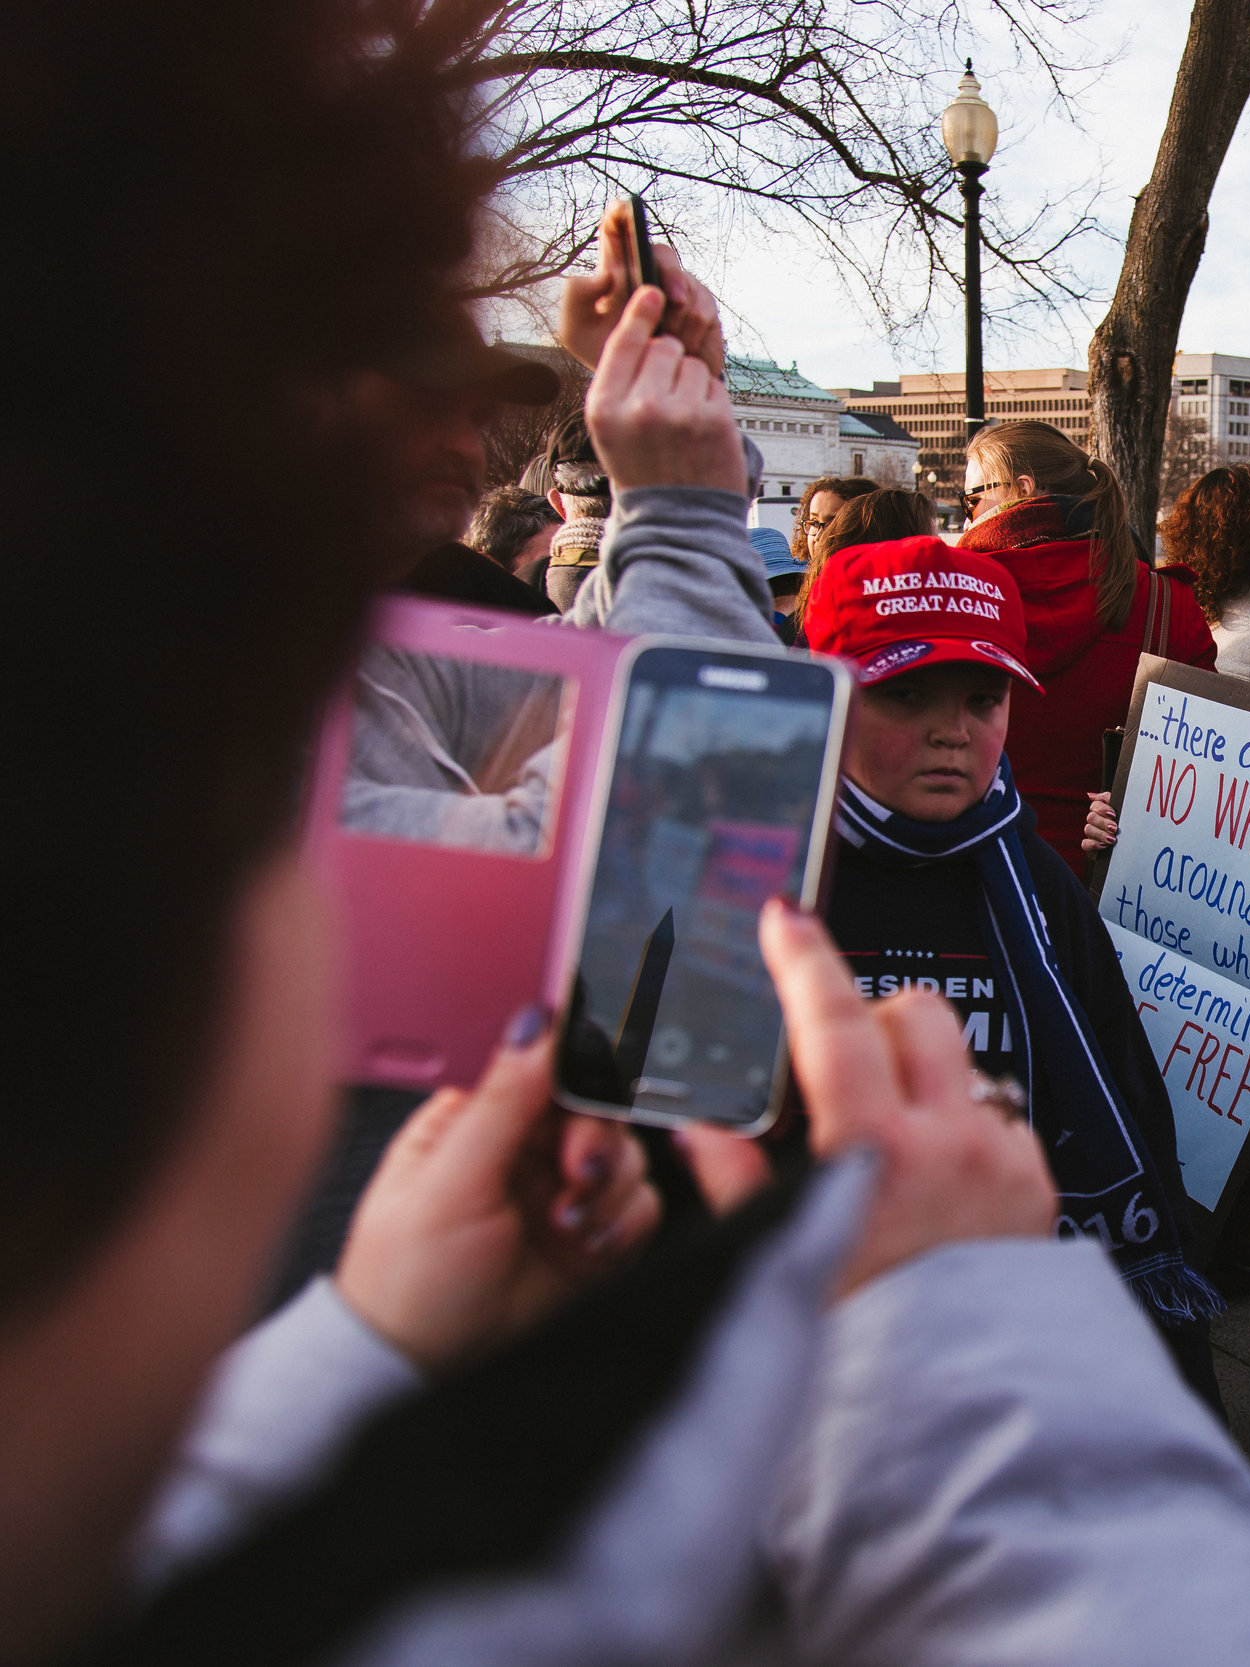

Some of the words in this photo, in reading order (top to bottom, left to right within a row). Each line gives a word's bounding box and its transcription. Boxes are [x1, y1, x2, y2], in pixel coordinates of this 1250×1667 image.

[863, 572, 922, 595] MAKE
[925, 571, 1006, 601] AMERICA
[876, 595, 943, 616] GREAT
[946, 596, 1000, 620] AGAIN
[1146, 754, 1197, 826] NO
[1116, 885, 1193, 955] those
[853, 974, 994, 999] ESIDEN
[1052, 1191, 1160, 1250] 016
